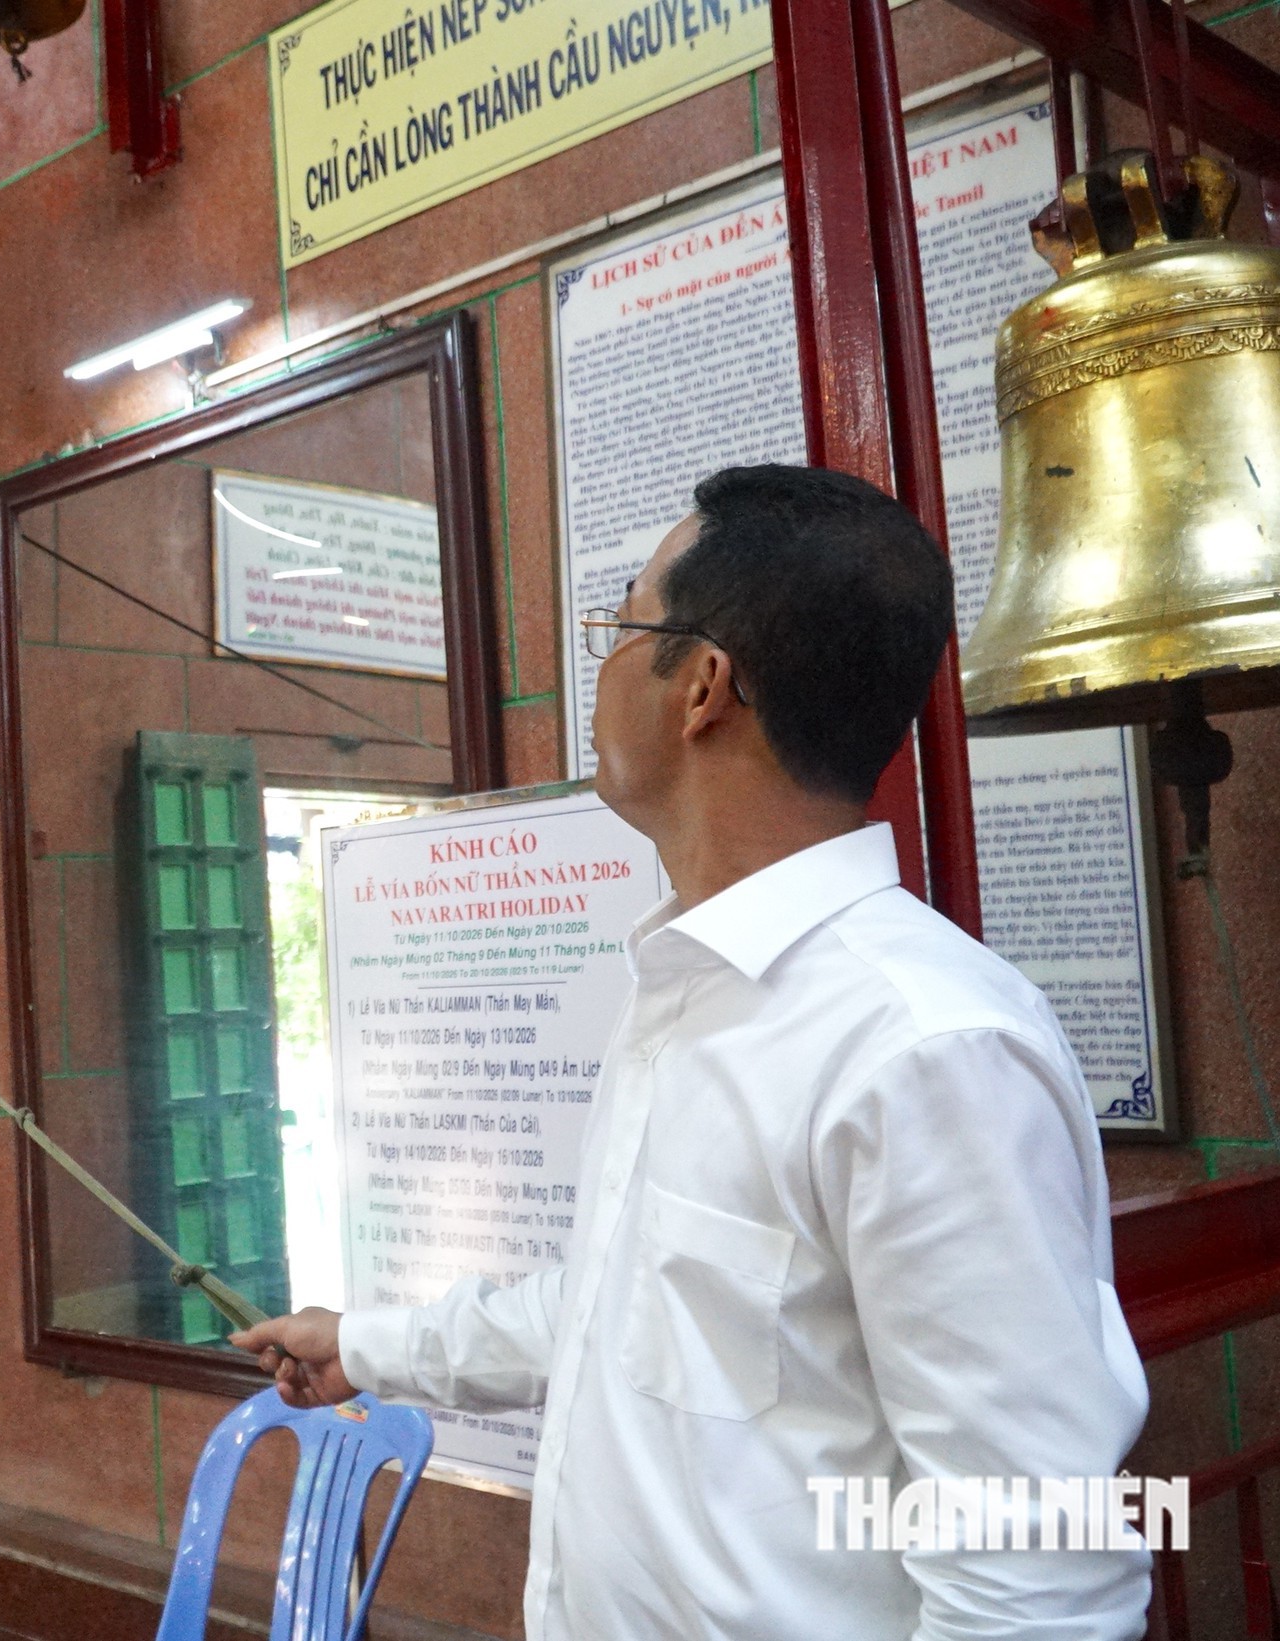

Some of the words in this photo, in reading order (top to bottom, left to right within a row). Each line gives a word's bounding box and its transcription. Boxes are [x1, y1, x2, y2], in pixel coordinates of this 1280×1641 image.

[320, 38, 377, 110] THỰC
[381, 8, 436, 80] HIỆN
[305, 138, 340, 211] CHỈ
[345, 119, 388, 194] CẦN
[393, 105, 454, 172] LÒNG
[458, 58, 542, 140] THÀNH
[548, 17, 601, 100] CẦU
[911, 148, 953, 178] IỆT
[960, 126, 1018, 163] NAM
[934, 183, 985, 213] Tamil
[591, 260, 638, 290] LỊCH
[643, 244, 668, 273] SỬ
[671, 228, 715, 262] CỦA
[718, 208, 766, 245] ĐỀN
[636, 295, 655, 313] Sự
[658, 288, 672, 306] có
[677, 279, 703, 300] mặt
[707, 271, 732, 288] của
[736, 254, 778, 280] người
[429, 836, 485, 864] KÍNH
[489, 828, 538, 858] CÁO
[355, 877, 377, 903] LỄ
[381, 878, 410, 900] VÍA
[414, 871, 451, 898] BỐN
[454, 871, 480, 894] NỮ
[483, 861, 537, 891] THẦN
[541, 862, 588, 886] NĂM
[591, 860, 632, 881] 2026
[390, 901, 496, 927] NAVARATRI
[500, 894, 590, 919] HOLIDAY
[408, 931, 432, 947] Ngày
[507, 925, 533, 941] Ngày
[535, 921, 590, 936] 20/10/2026
[447, 950, 476, 964] Tháng
[554, 944, 587, 959] Tháng
[589, 943, 596, 955] 9
[514, 993, 533, 1016] May
